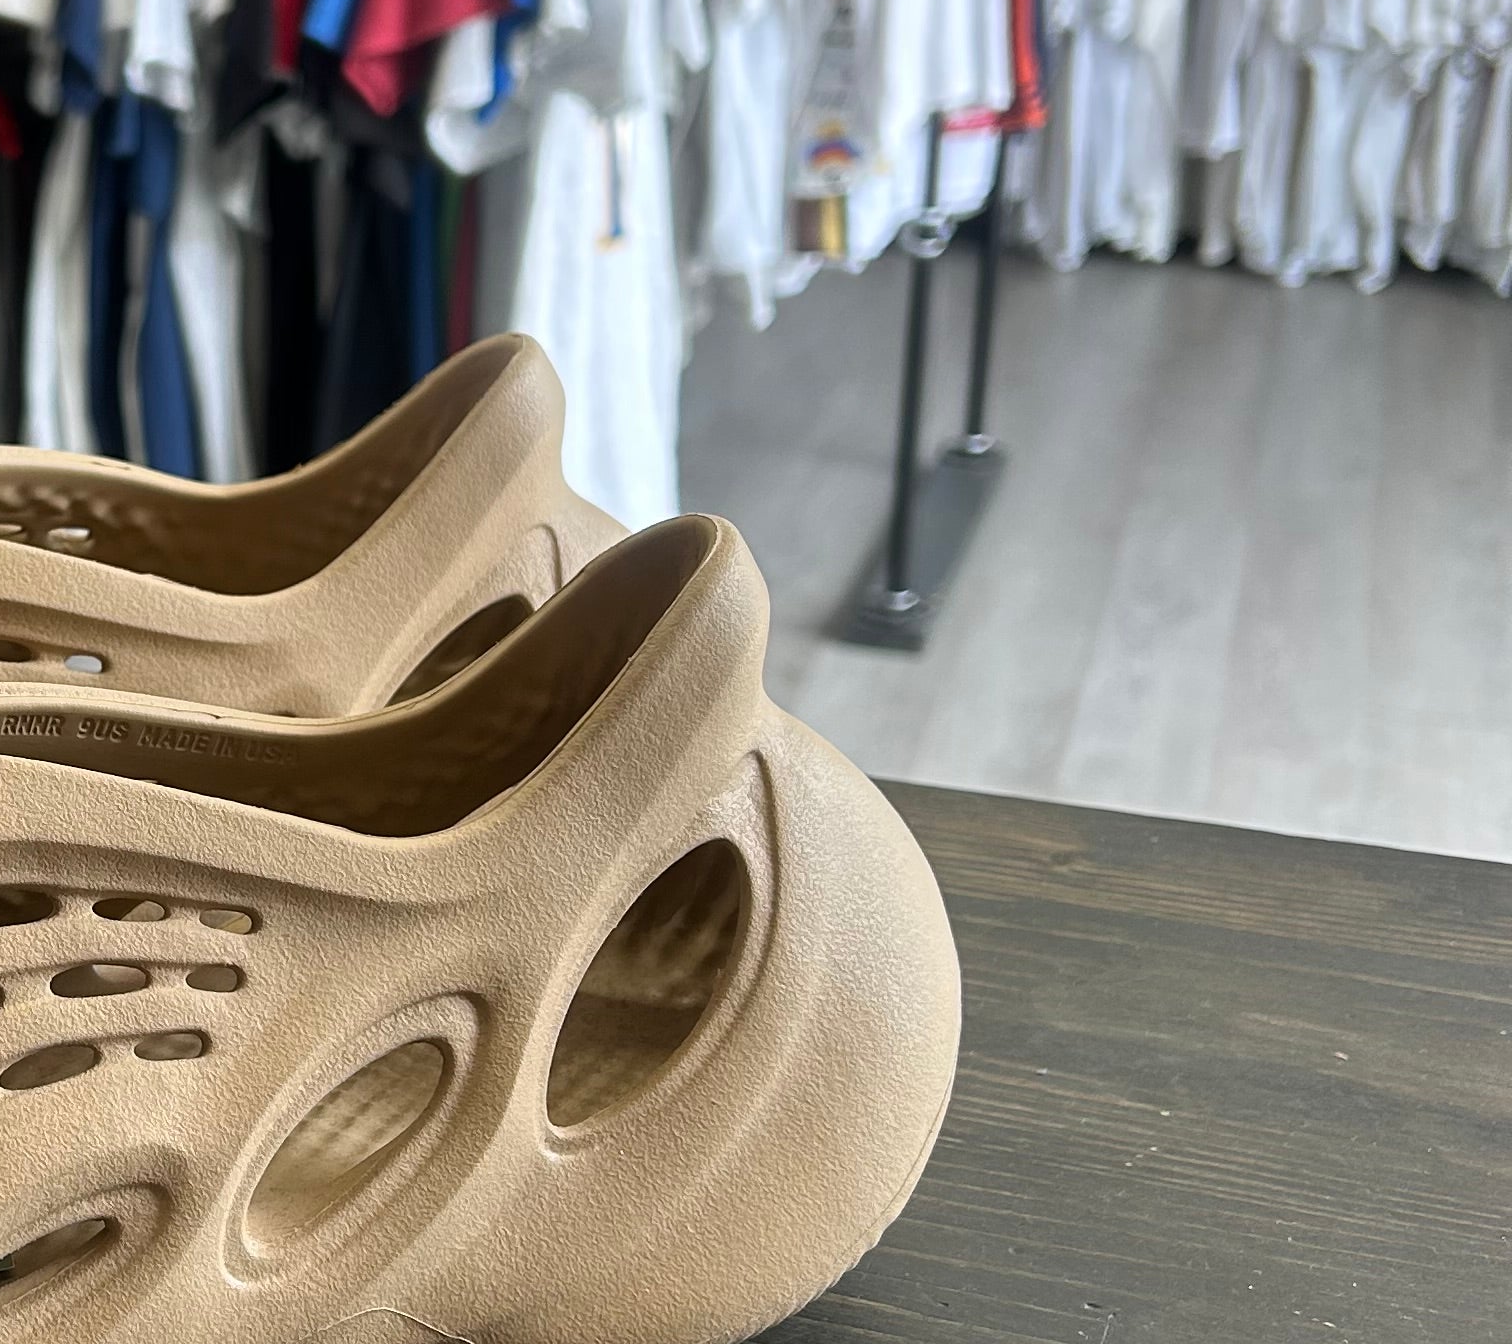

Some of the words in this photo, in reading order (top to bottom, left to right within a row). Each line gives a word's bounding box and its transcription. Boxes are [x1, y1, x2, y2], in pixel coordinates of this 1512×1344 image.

[1, 715, 64, 737] RNNR
[77, 718, 129, 743] 9US
[137, 725, 210, 754] MADE
[212, 734, 237, 757] IN
[244, 739, 296, 766] USA
